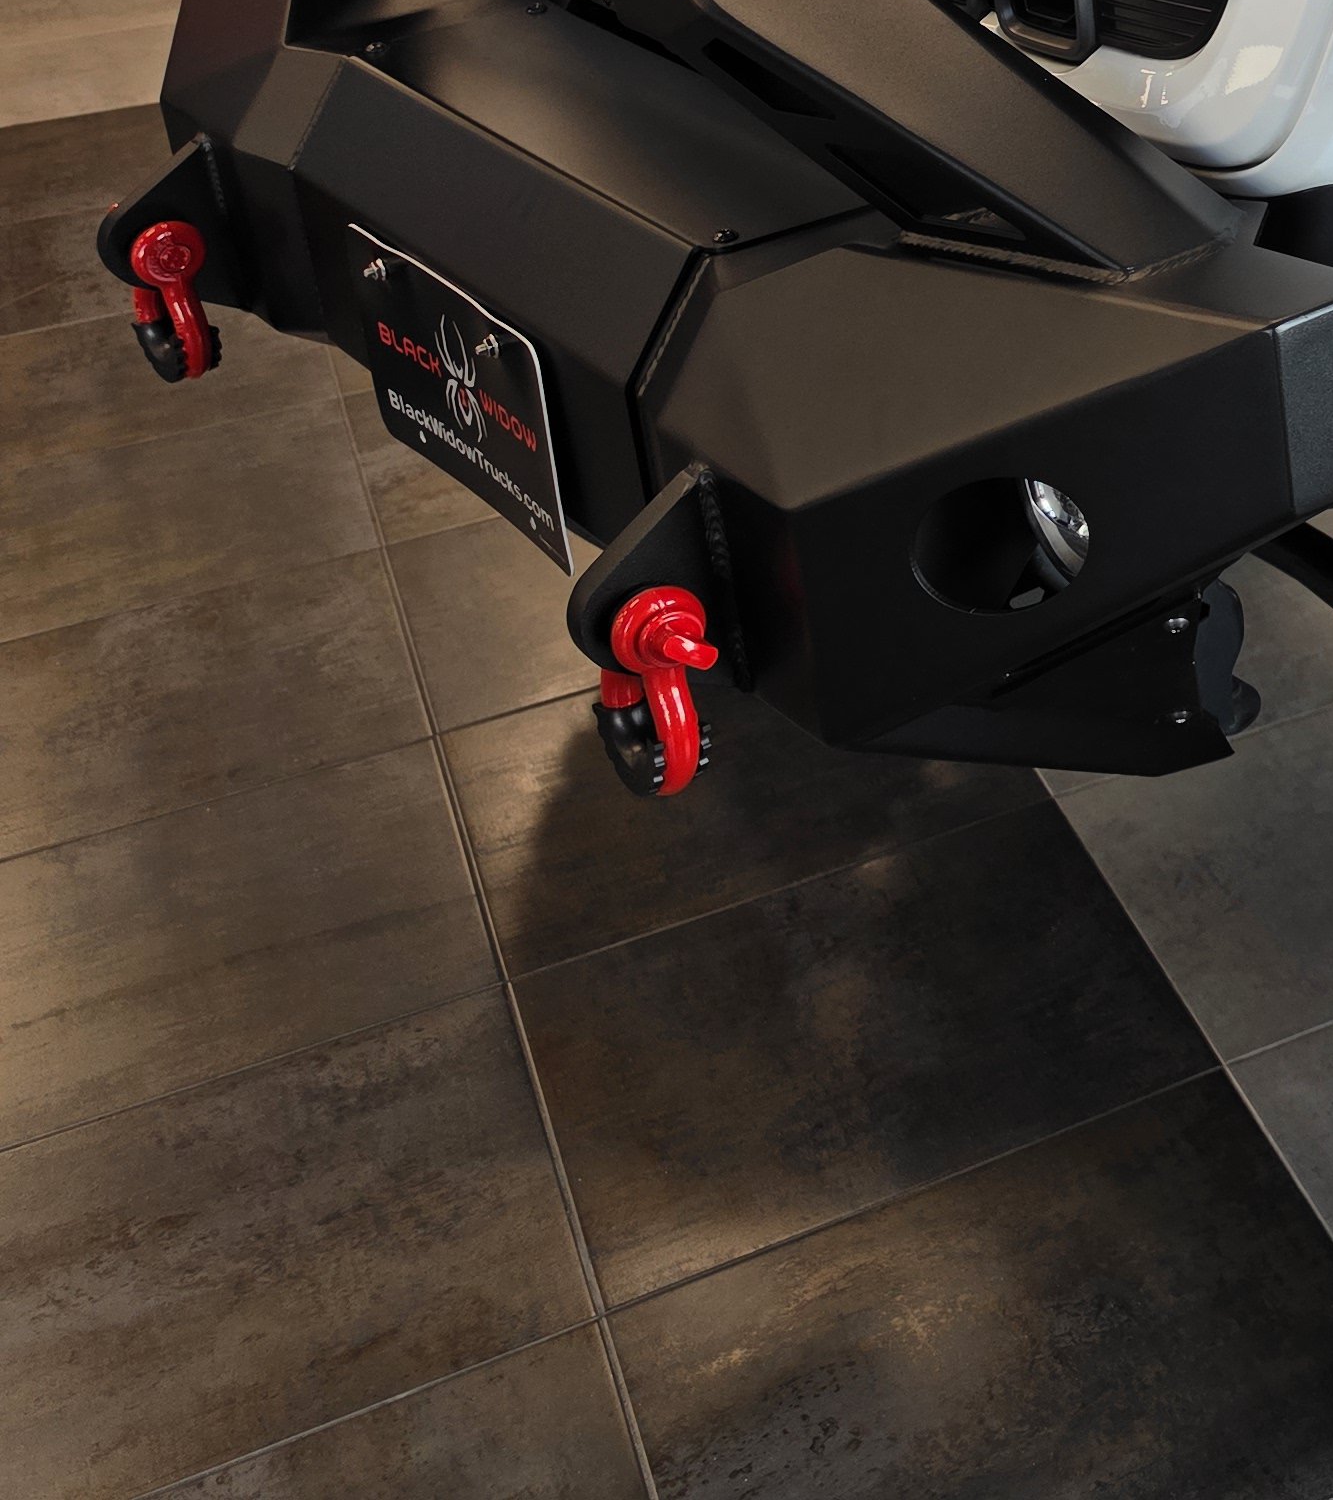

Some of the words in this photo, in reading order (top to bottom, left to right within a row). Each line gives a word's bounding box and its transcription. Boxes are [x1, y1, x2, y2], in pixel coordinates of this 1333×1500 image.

[377, 321, 443, 379] BLACK
[479, 387, 537, 452] WIDOW
[387, 388, 555, 532] BlackWidowTrucks.com
